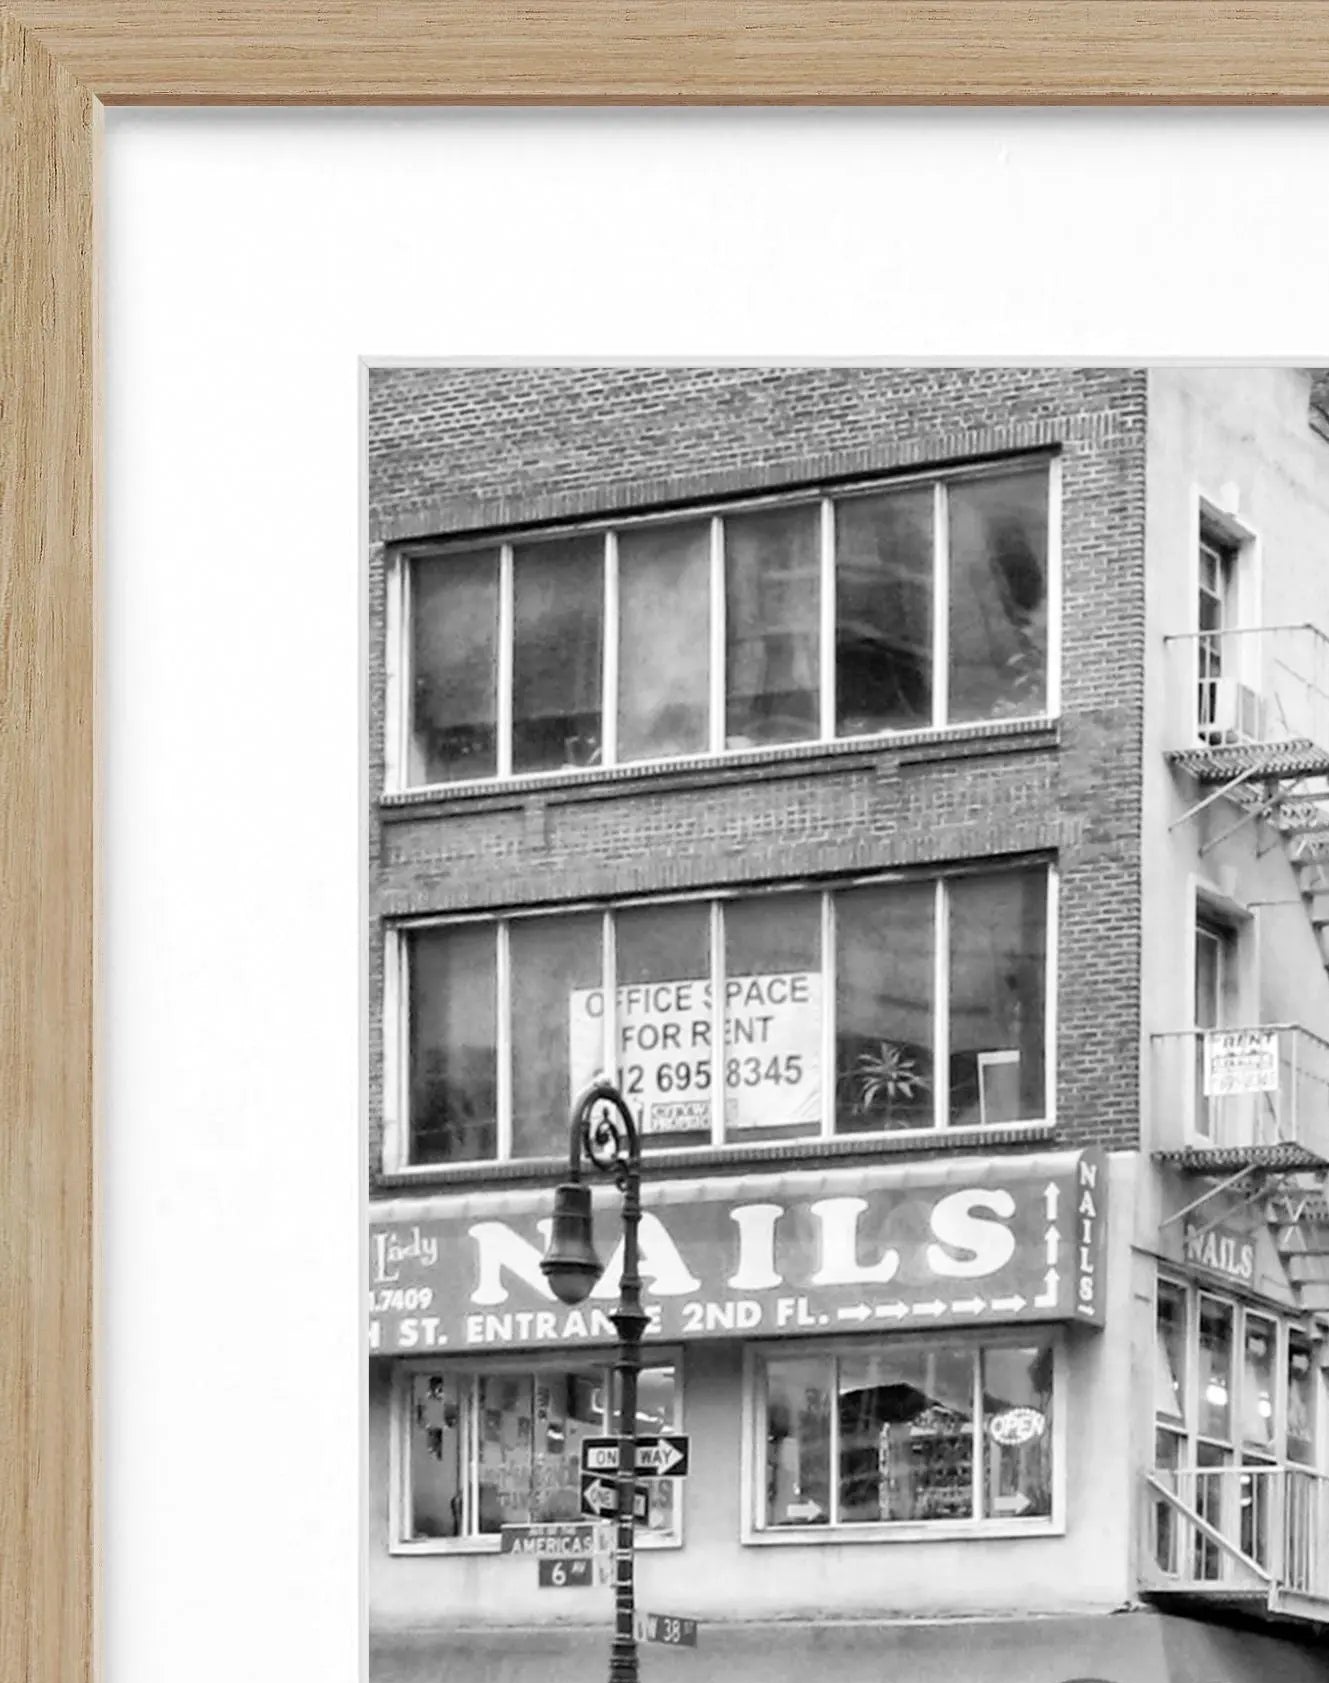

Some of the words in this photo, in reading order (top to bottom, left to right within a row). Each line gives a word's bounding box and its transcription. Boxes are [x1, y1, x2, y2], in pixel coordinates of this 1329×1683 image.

[585, 983, 693, 1018] OFICE
[622, 1022, 681, 1052] FOR
[656, 1060, 711, 1094] 695
[726, 1054, 803, 1089] 8345
[1078, 1160, 1097, 1301] NAILS
[468, 1189, 1016, 1305] NAILS
[1186, 1223, 1254, 1280] NAILS
[399, 1317, 449, 1347] ST.
[466, 1306, 662, 1344] ENTRANE
[682, 1301, 762, 1331] 2ND
[777, 1297, 829, 1326] FL.
[993, 1411, 1046, 1440] OPEN
[595, 1451, 617, 1465] ON
[639, 1451, 672, 1465] WAY
[510, 1535, 594, 1554] AMERICAS
[551, 1562, 566, 1586] 6
[663, 1618, 681, 1642] 38
